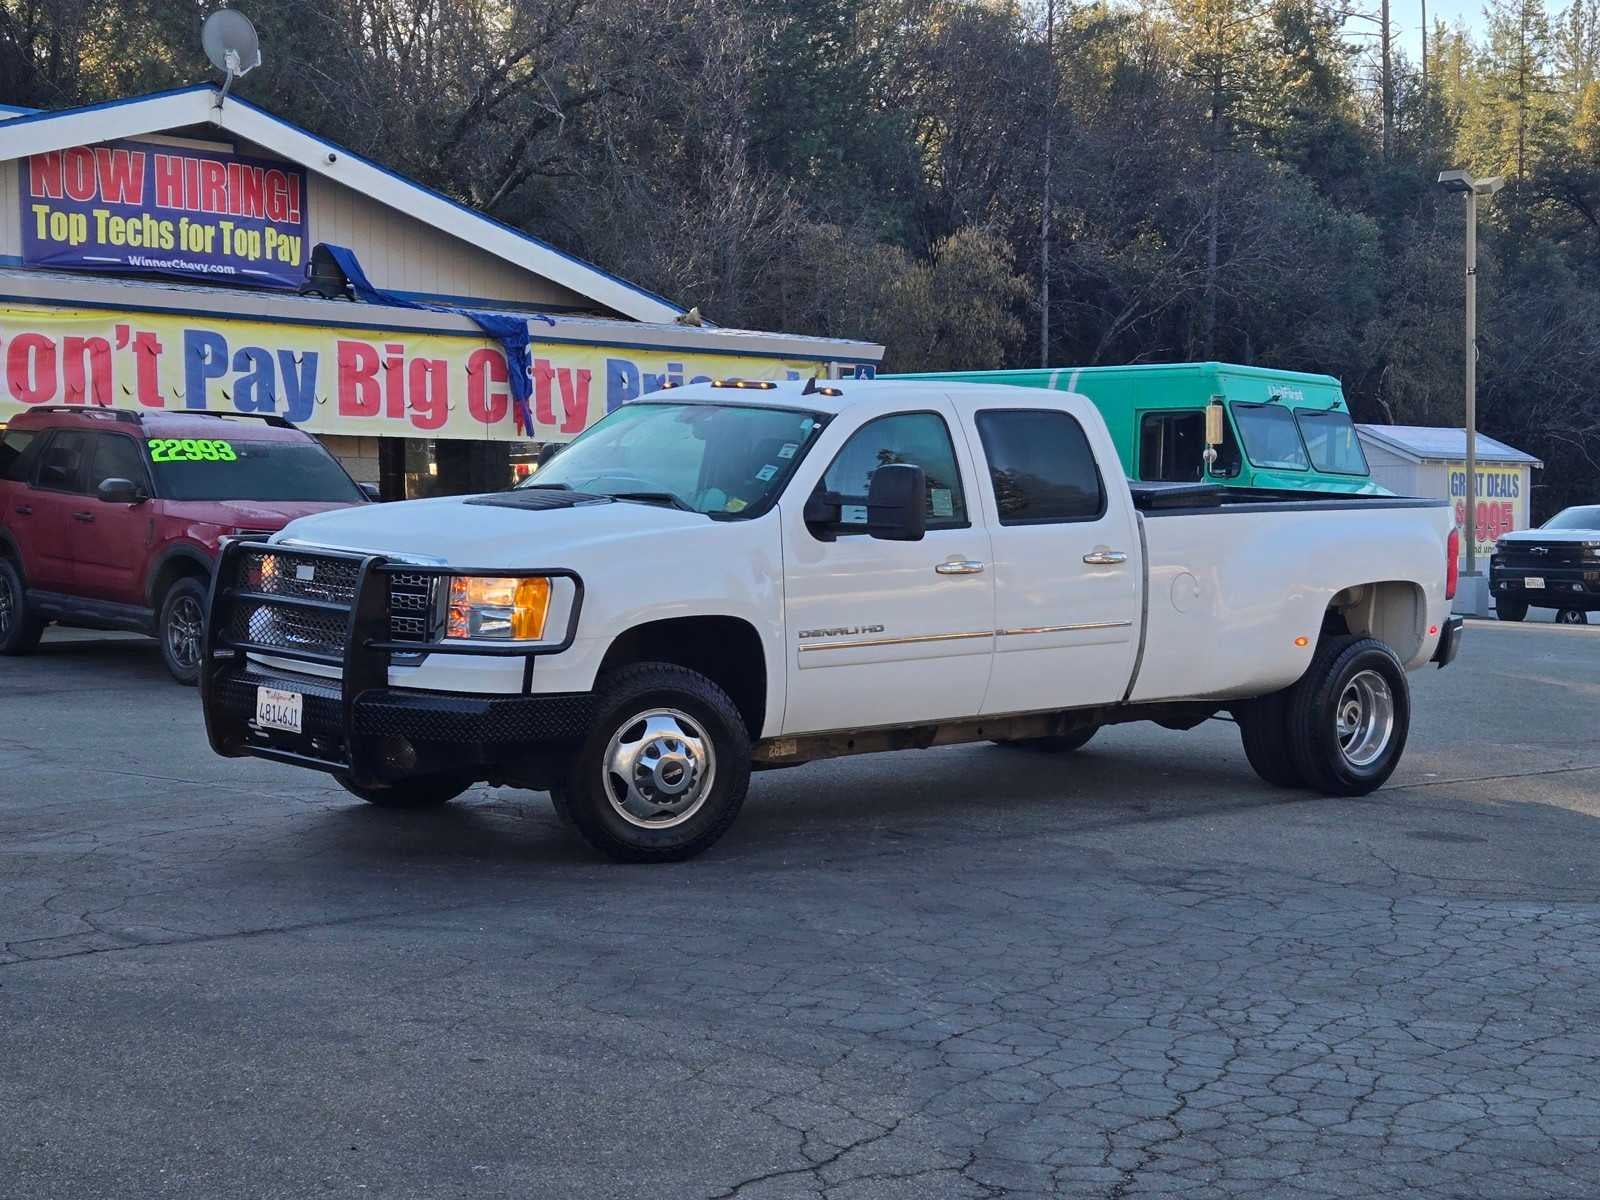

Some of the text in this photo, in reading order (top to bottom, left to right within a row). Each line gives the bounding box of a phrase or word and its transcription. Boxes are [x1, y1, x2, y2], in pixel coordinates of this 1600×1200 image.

[30, 145, 301, 224] NOW HIRING!
[32, 204, 302, 266] Top Techs for Top Pay
[127, 255, 236, 274] WinnerChevy.com
[0, 324, 165, 408] on't
[184, 329, 319, 422] Pay
[337, 340, 448, 430] Big
[147, 438, 238, 462] 22993
[1486, 473, 1520, 498] DEALS
[799, 624, 885, 638] DENALI HD
[259, 701, 299, 727] 48146J1
